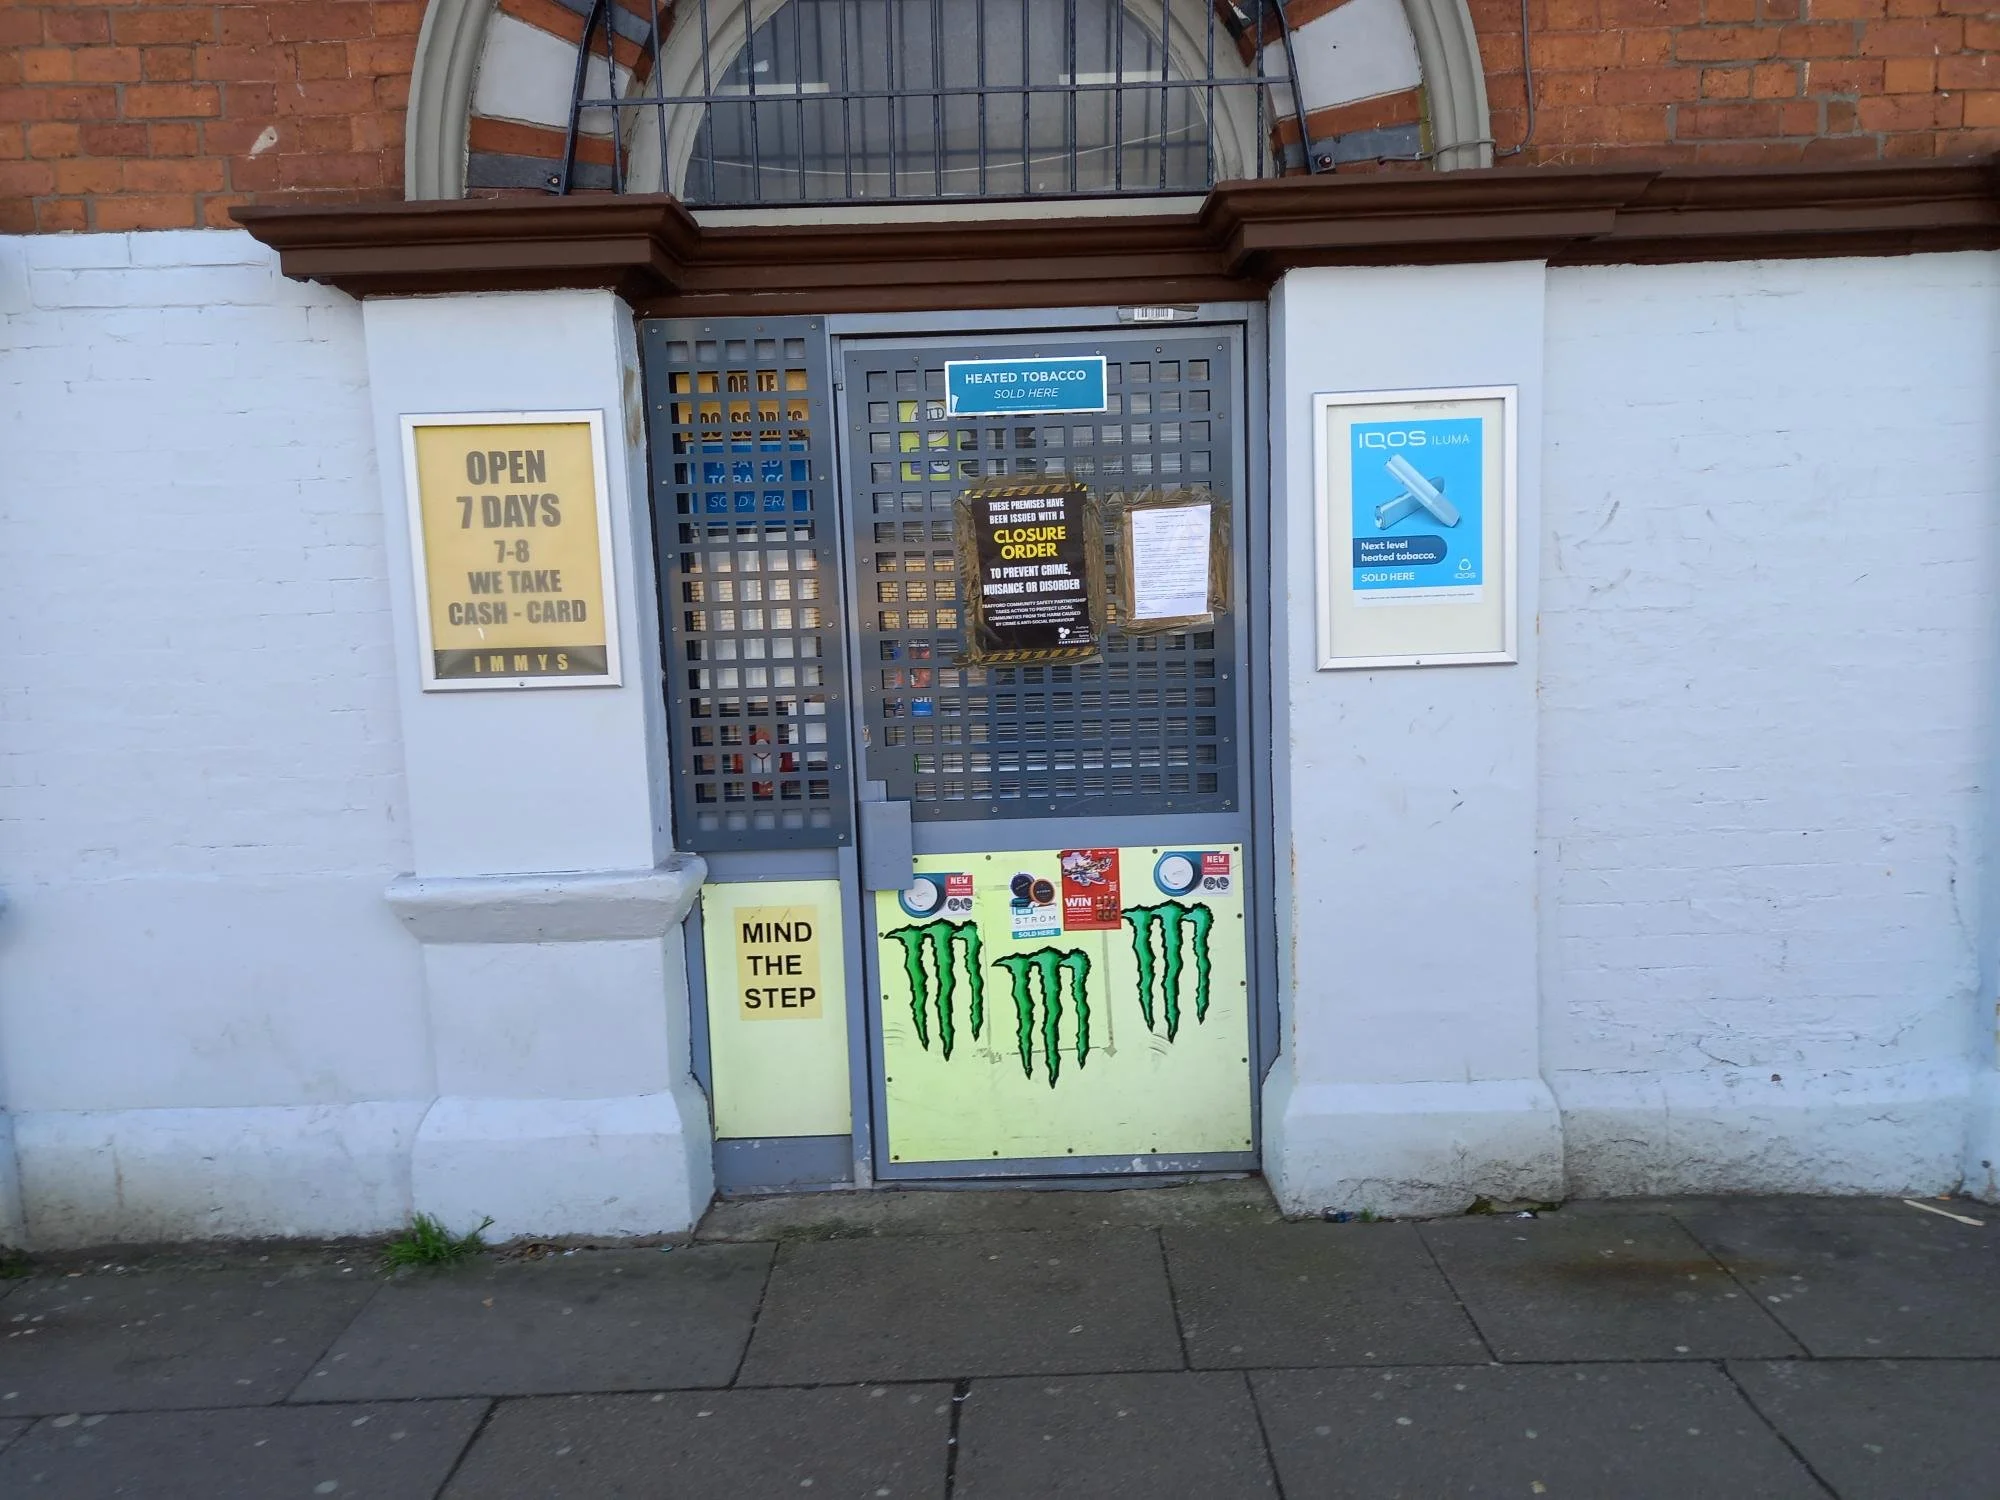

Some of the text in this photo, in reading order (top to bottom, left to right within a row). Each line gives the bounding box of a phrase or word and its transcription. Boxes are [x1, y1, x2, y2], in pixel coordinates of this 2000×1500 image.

[965, 370, 1087, 385] HEATED TOBACCO
[994, 387, 1060, 399] SOLD HERE
[1358, 430, 1471, 450] IQOS ILUMA
[466, 450, 546, 486] OPEN
[456, 493, 561, 529] 7 DAYS
[988, 497, 1065, 512] THESE PREMISES HAVE
[989, 510, 1065, 525] BEEN ISSUED WITH A
[993, 525, 1067, 544] CLOSURE
[494, 539, 530, 563] 7-8
[1001, 542, 1058, 560] ORDER
[1361, 540, 1408, 550] Next level
[1361, 551, 1437, 562] heated tobacco.
[990, 563, 1071, 580] TO PREVENT CRIME,
[1361, 571, 1415, 582] SOLD HERE
[468, 569, 562, 595] WE TAKE
[983, 579, 1080, 596] NUISANCE OR DISORDER
[448, 602, 508, 626] CASH
[527, 600, 587, 624] CARD
[1206, 855, 1225, 863] NEW
[950, 876, 969, 885] NEW
[1065, 897, 1092, 907] WIN
[742, 922, 812, 943] MIND
[746, 955, 802, 976] THE
[745, 987, 816, 1009] STEP
